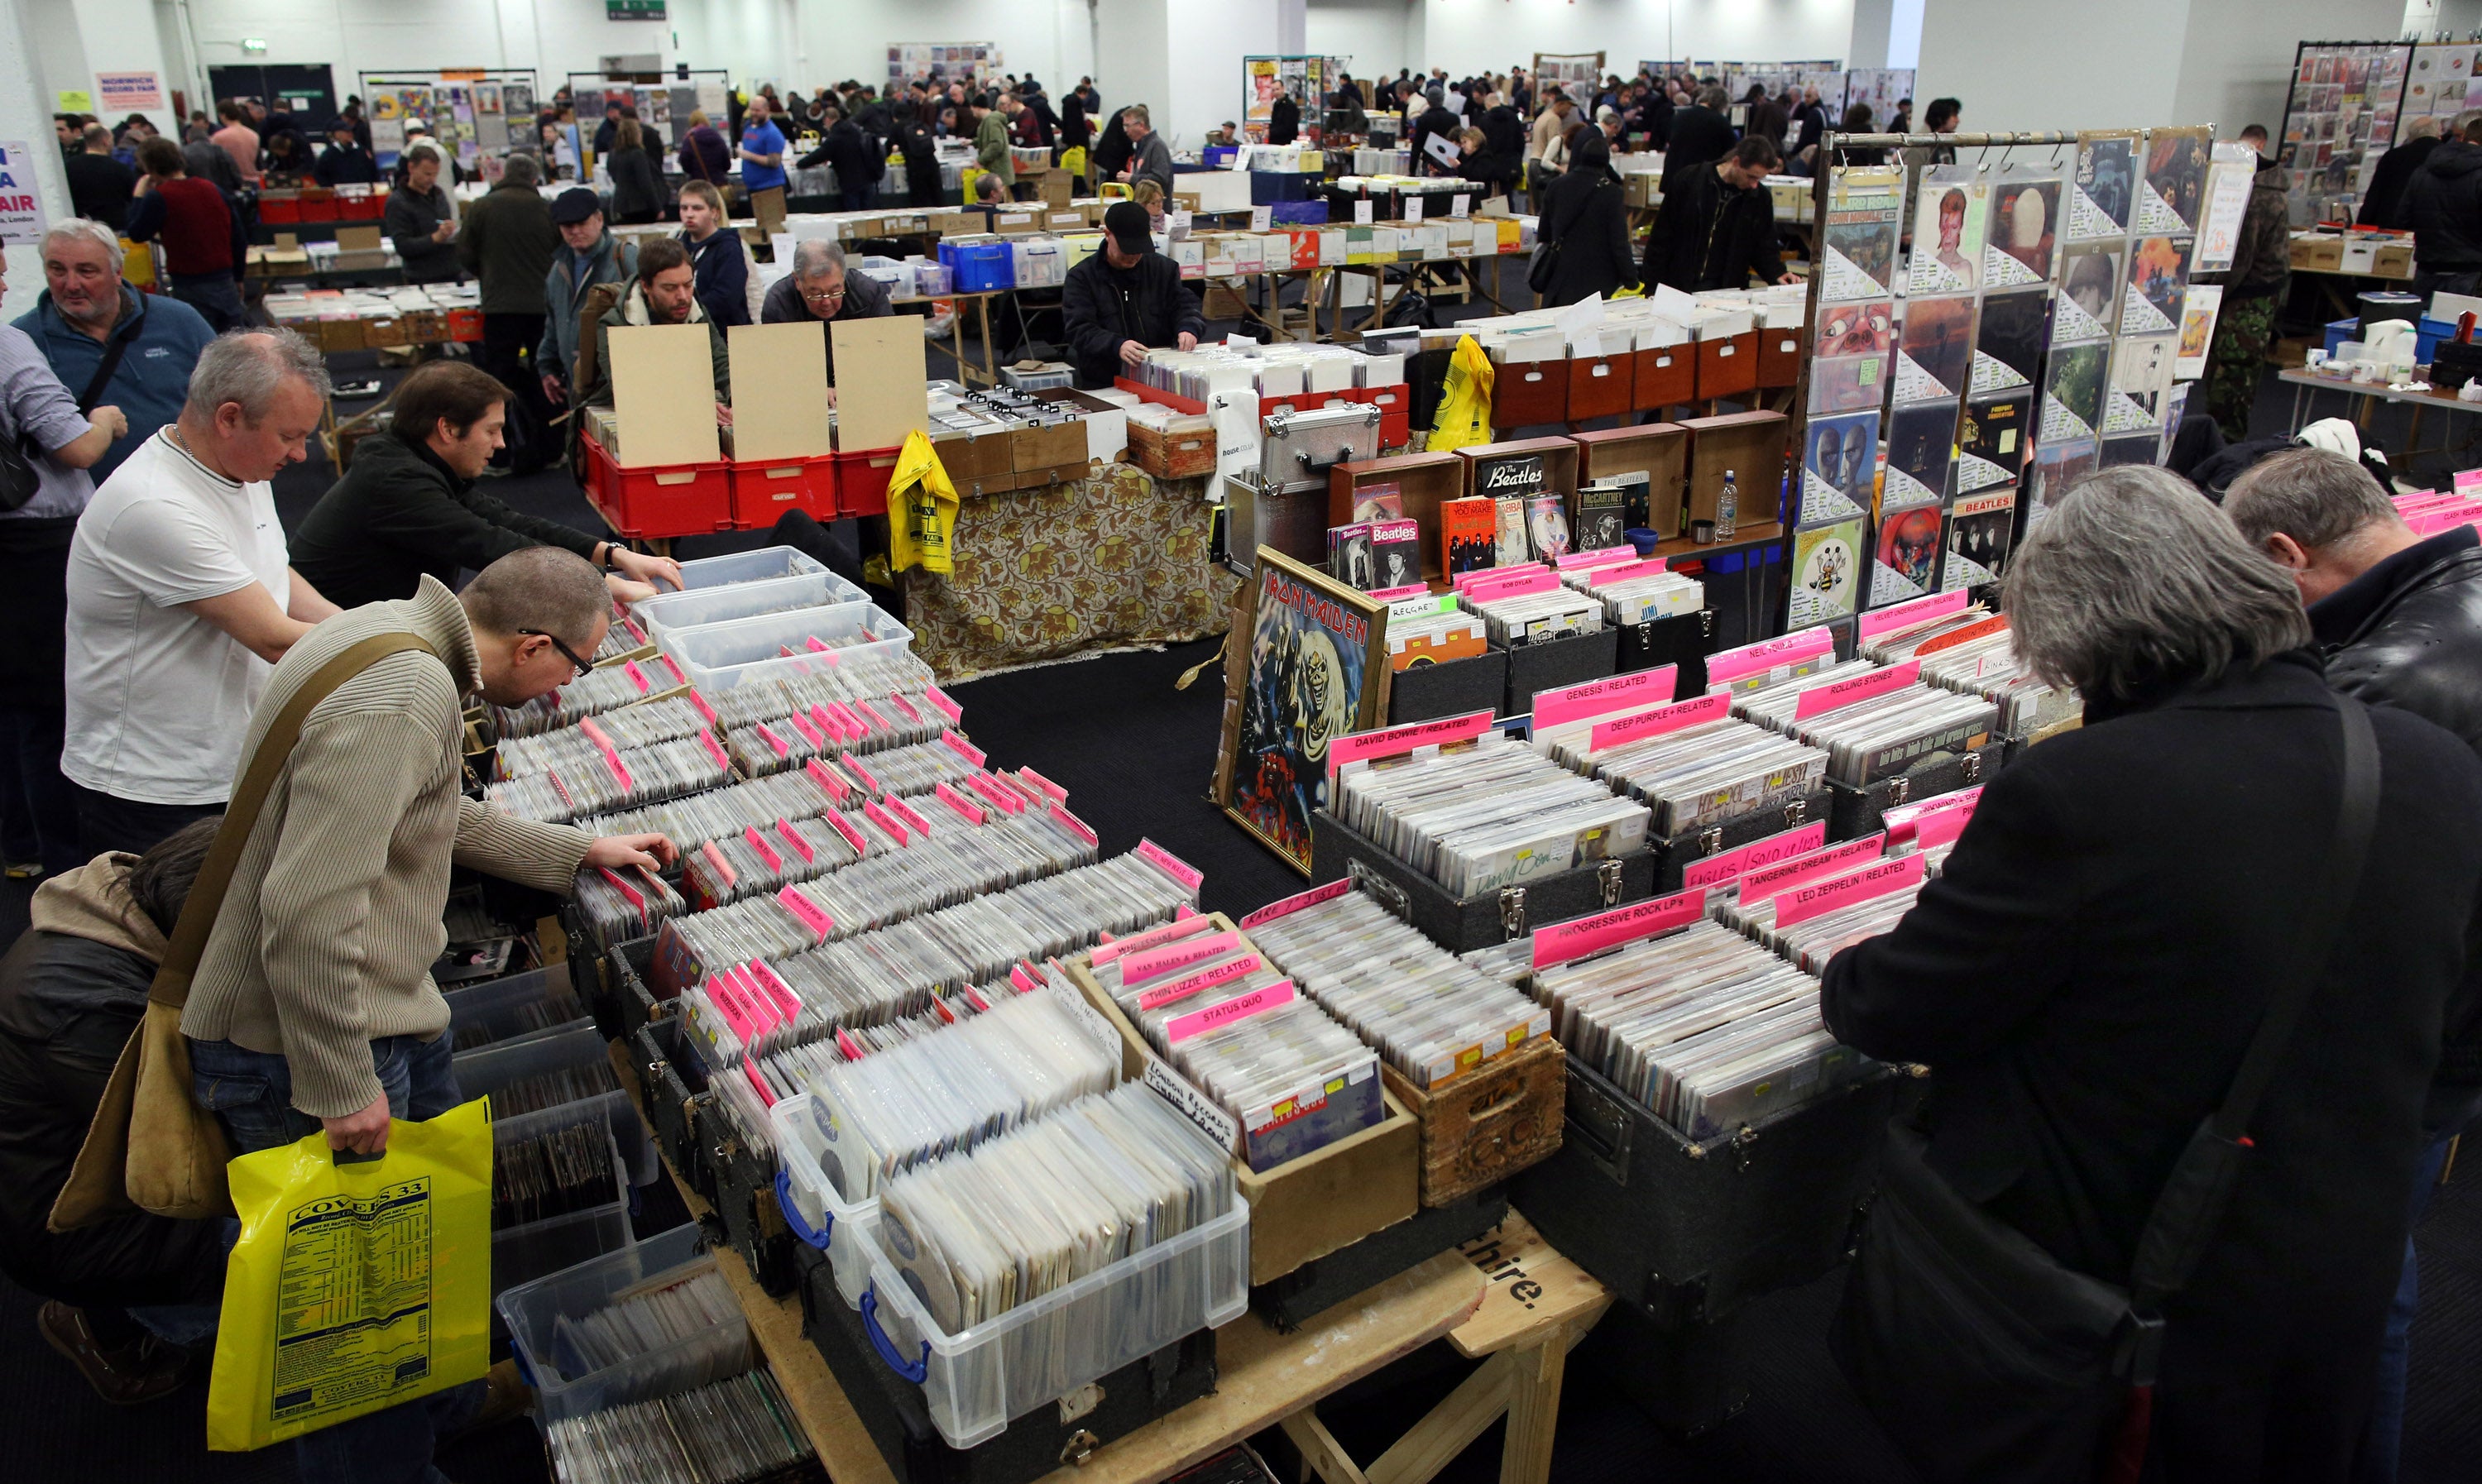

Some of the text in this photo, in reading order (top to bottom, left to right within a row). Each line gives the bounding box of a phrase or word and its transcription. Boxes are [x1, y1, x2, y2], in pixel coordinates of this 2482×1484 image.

[1487, 464, 1543, 489] Beatles
[1506, 465, 1517, 473] The
[1618, 474, 1644, 486] BEATLES
[1472, 500, 1492, 508] LOVE
[1583, 491, 1624, 505] McCARTNEY
[1965, 496, 2014, 513] BEATLES!
[1453, 506, 1493, 516] YOU MAKE
[1343, 527, 1363, 539] Beatles
[1373, 526, 1416, 542] Beatles
[1624, 562, 1644, 572] HENDRIX
[1373, 586, 1411, 598] SPRINGSTEEN
[1515, 579, 1533, 588] DYLAN
[1264, 571, 1368, 648] IRON MAIDEN
[1641, 604, 1658, 620] JIMI
[1874, 594, 1956, 621] VELVET UNDERGROUND RELATED
[1749, 640, 1793, 658] NEIL YOUNG
[1566, 674, 1647, 701] GENESIS RELATED
[1830, 670, 1893, 696] ROLLING STONES
[1610, 720, 1634, 733] DEEP
[1634, 711, 1670, 729] PURPLE
[1676, 699, 1714, 716] RELATED
[1354, 717, 1470, 748] DAVID BOWIE RELATED
[949, 736, 977, 760] ROLLING STONES
[1879, 750, 1890, 767] big
[1890, 746, 1904, 764] hits
[1160, 856, 1186, 876] NEW WAVE
[1690, 863, 1737, 888] EAGLES
[1748, 862, 1800, 887] TANGERINE
[1800, 852, 1833, 872] DREAM
[1839, 840, 1876, 862] RELATED
[1797, 862, 1906, 903] LED ZEPPELIN RELATED
[1558, 898, 1684, 937] PROGRESSIVE ROCK LP's
[1118, 931, 1173, 955] WHITESNAKE
[1137, 963, 1152, 973] VAN
[1155, 958, 1181, 969] HALEN
[1193, 945, 1227, 960] RELATED
[756, 966, 794, 1007] SMITHS MORRISSEY
[1148, 958, 1252, 1003] THIN LIZZIE RELATED
[719, 990, 742, 1021] BUZZCOCKS
[738, 992, 751, 1012] CLASH
[1203, 993, 1263, 1022] STATUS QUO
[1150, 1060, 1184, 1099] LONDON
[1188, 1092, 1231, 1137] RECORDS
[295, 1191, 391, 1220] COVERS
[397, 1183, 422, 1198] 33
[1456, 1232, 1543, 1309] hire.
[321, 1377, 370, 1395] COVERS
